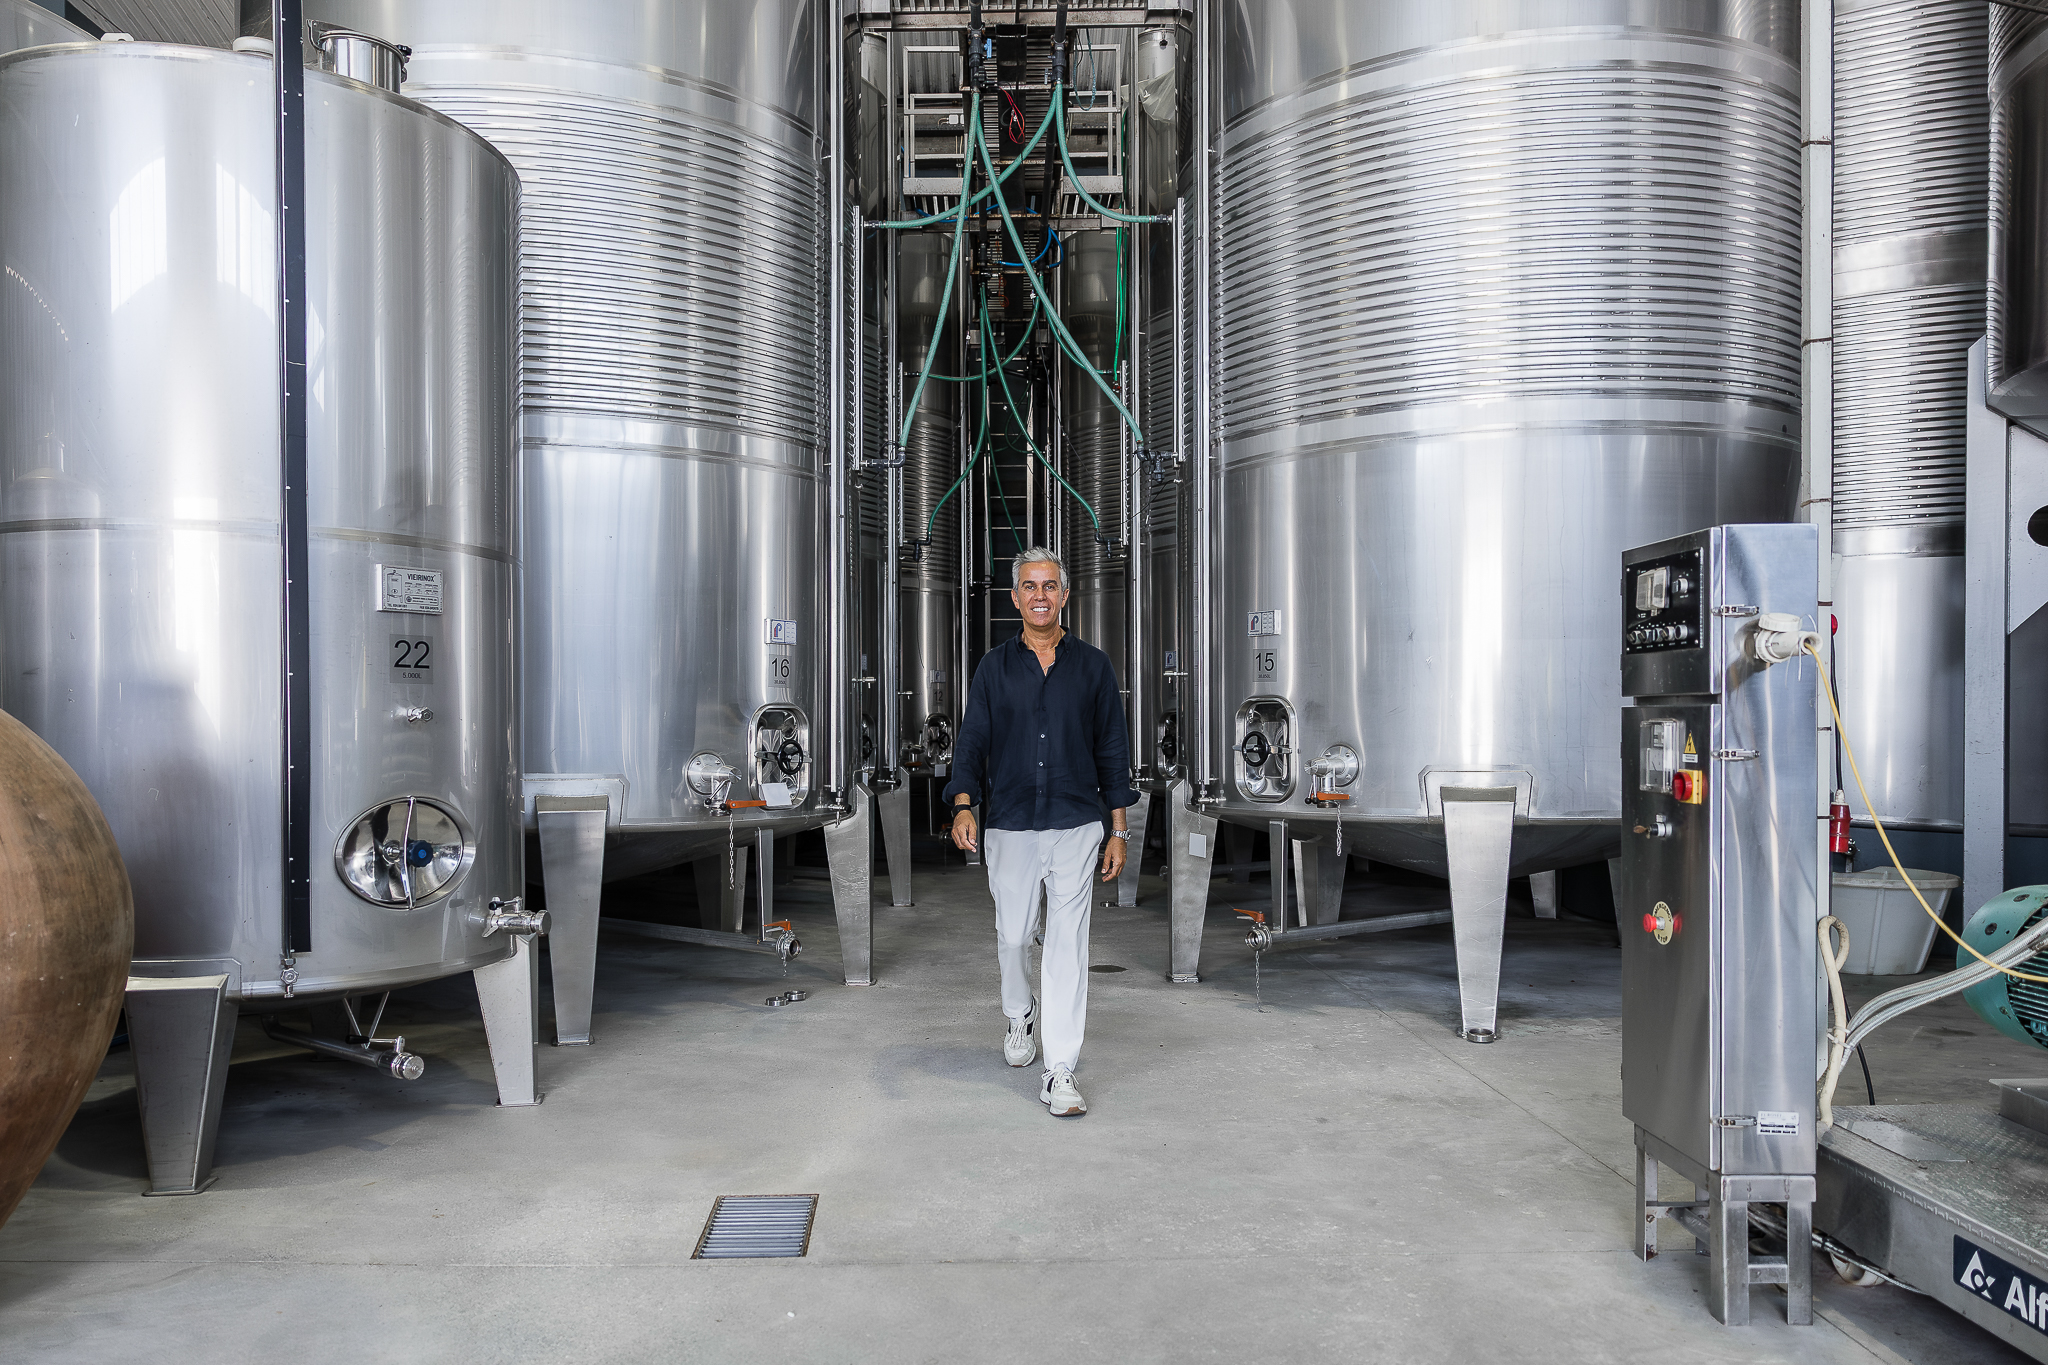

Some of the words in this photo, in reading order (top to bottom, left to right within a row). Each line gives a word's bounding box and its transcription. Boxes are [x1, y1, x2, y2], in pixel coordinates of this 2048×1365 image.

[407, 573, 435, 583] VIEIRINOX
[394, 639, 430, 669] 22
[1255, 652, 1274, 672] 15
[772, 657, 790, 678] 16
[934, 690, 943, 702] 12
[2004, 1276, 2048, 1330] Alf
